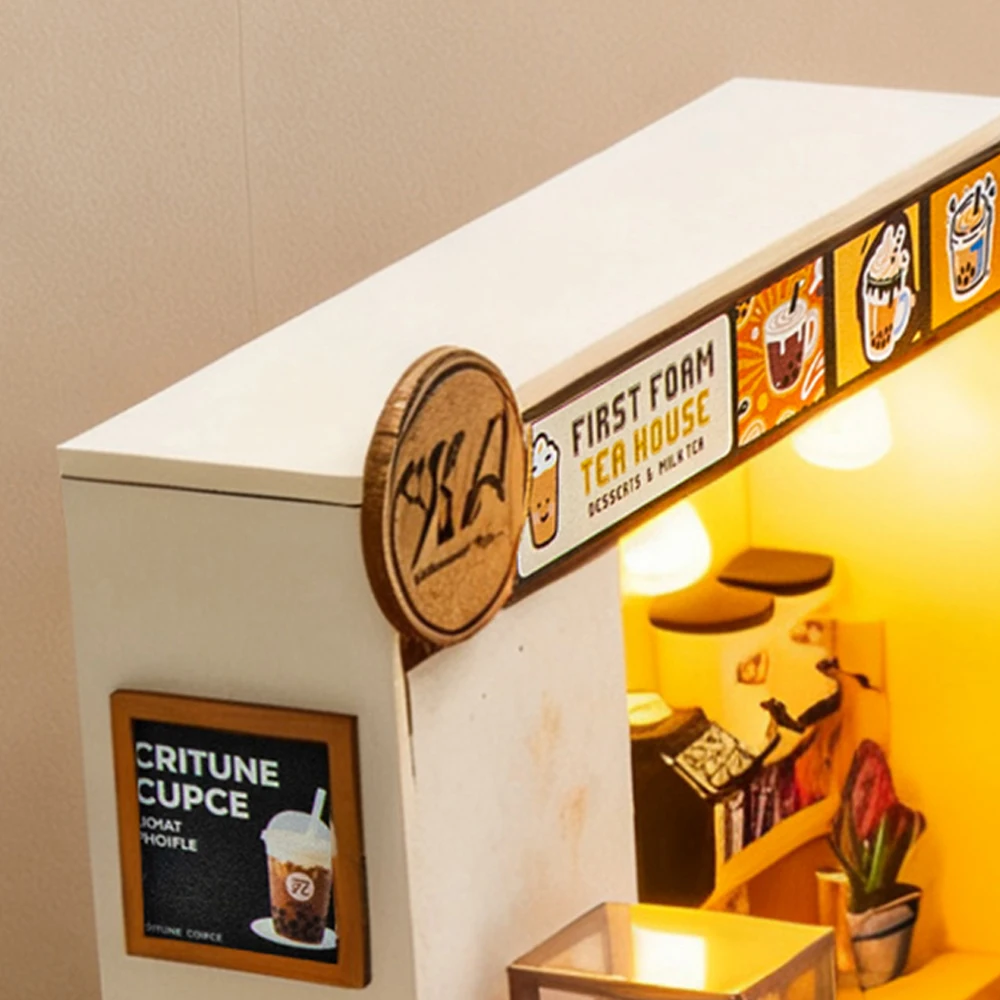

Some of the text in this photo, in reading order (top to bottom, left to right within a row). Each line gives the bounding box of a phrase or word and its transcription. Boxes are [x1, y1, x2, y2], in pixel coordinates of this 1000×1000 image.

[571, 339, 714, 458] FIRST FOAM
[580, 387, 711, 496] TEA HOUSE
[588, 473, 642, 518] DESSERTS
[658, 448, 684, 475] MILK
[685, 436, 704, 457] TEA
[136, 741, 280, 787] CRITUNE
[138, 777, 249, 819] CUPCE
